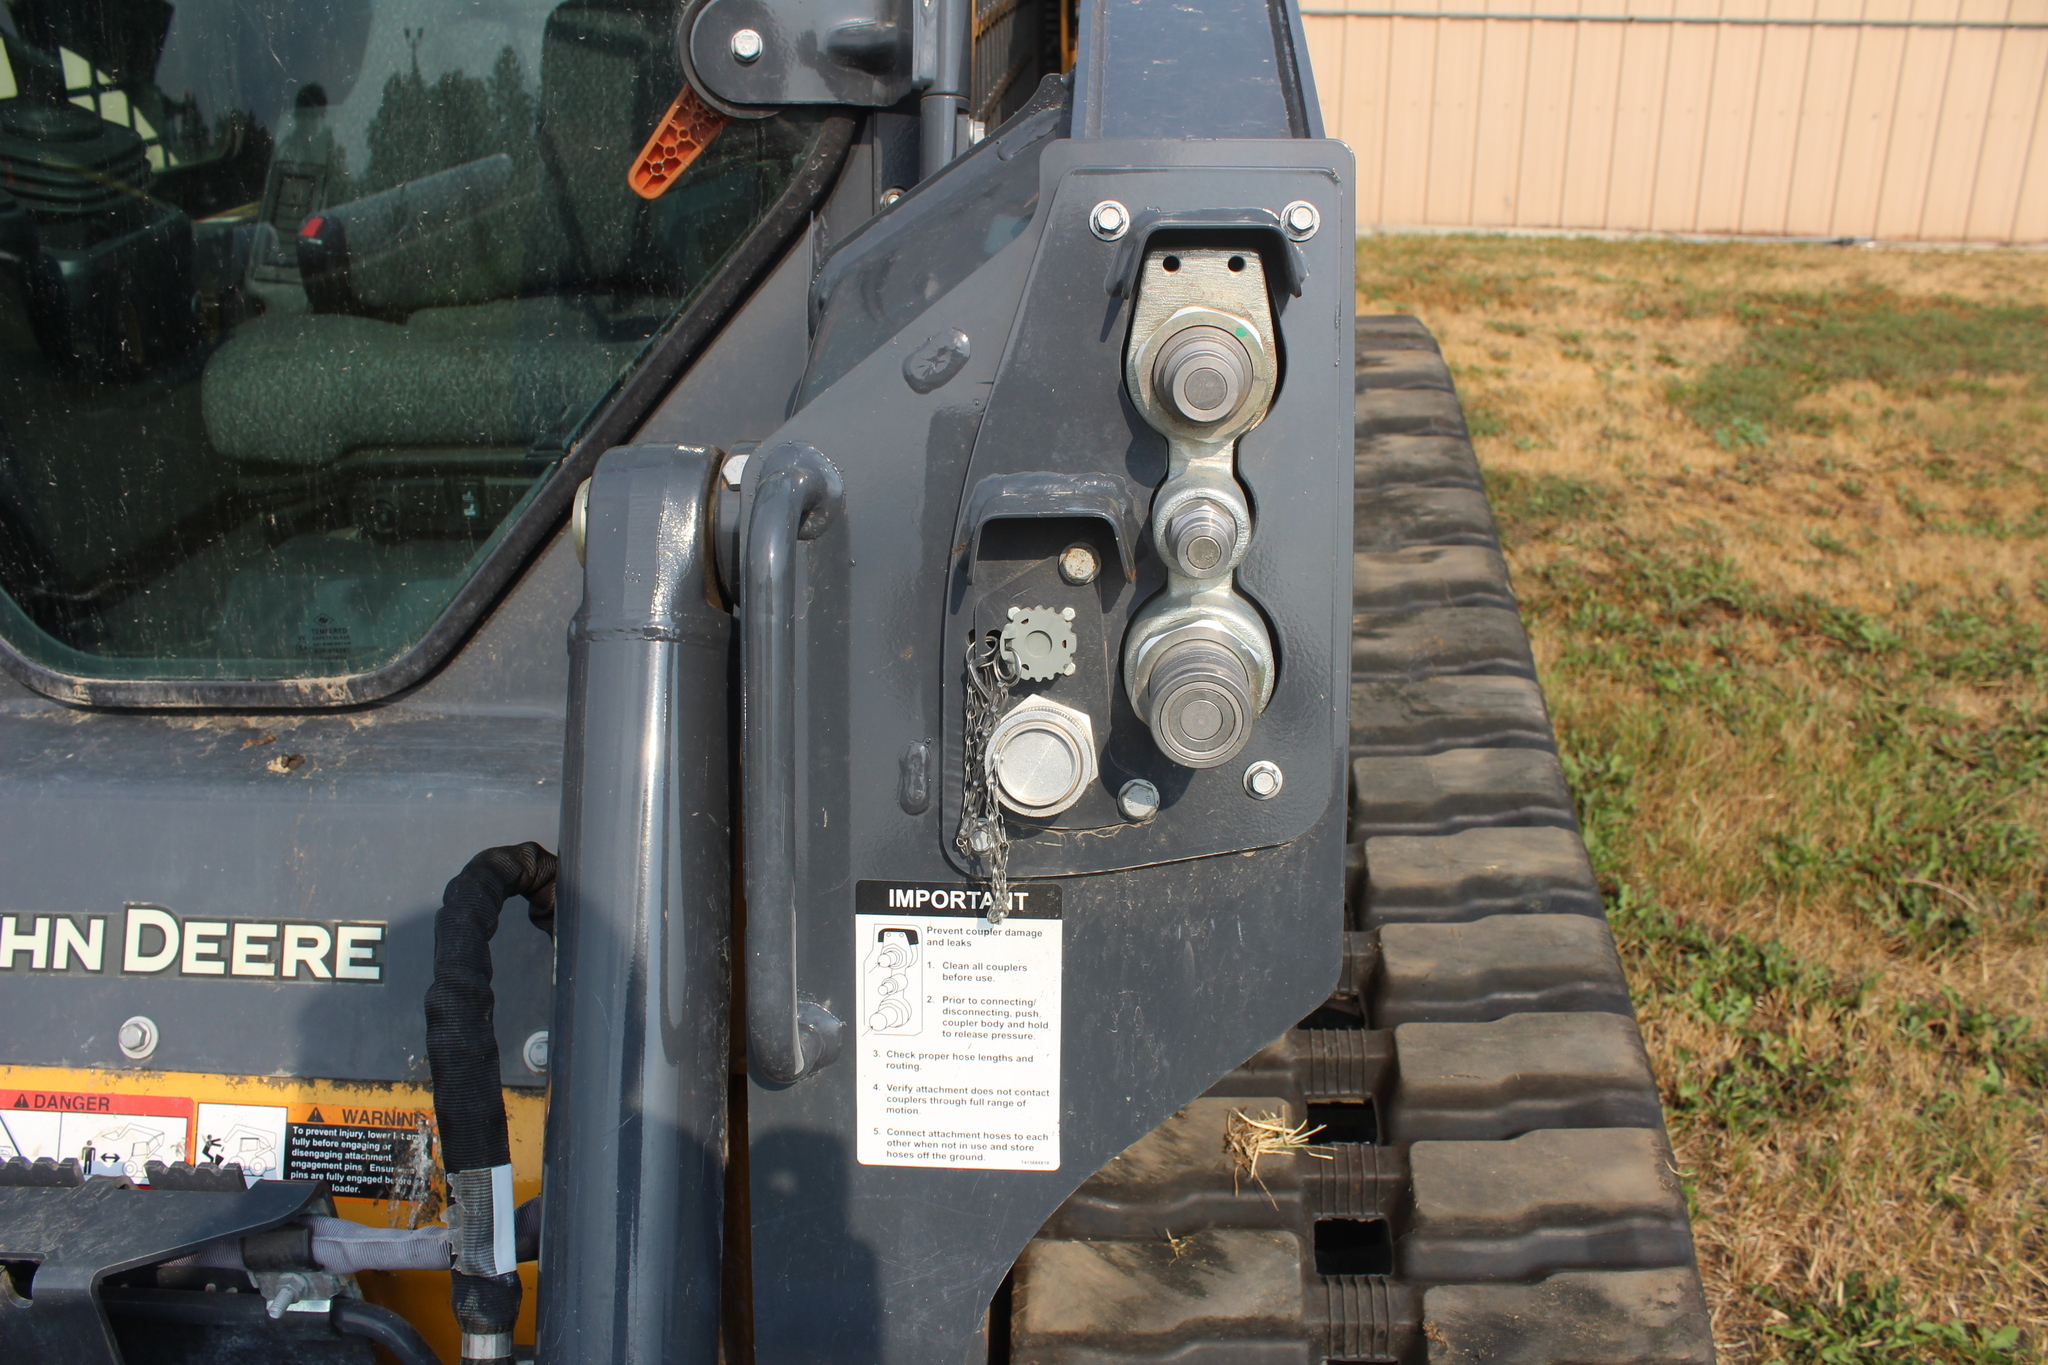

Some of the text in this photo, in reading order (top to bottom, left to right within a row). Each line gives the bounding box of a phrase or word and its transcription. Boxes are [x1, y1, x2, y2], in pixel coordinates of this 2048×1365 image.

[927, 927, 1043, 938] Prevent coupler damage
[123, 908, 383, 980] DEERE
[927, 939, 972, 947] and leaks
[943, 962, 969, 970] Clean
[972, 963, 983, 971] all
[986, 963, 1028, 973] couplers
[942, 974, 973, 982] before
[943, 996, 965, 1004] Prior
[981, 998, 1036, 1007] connecting/
[942, 1008, 1012, 1018] disconnecting,
[942, 1019, 978, 1028] coupler
[981, 1020, 1004, 1029] body
[955, 1031, 989, 1039] release
[991, 1033, 1036, 1041] pressure.
[873, 1050, 881, 1058] 3.
[887, 1051, 915, 1059] Check
[918, 1053, 950, 1061] proper
[953, 1053, 975, 1061] hose
[978, 1054, 1013, 1063] lengths
[886, 1062, 922, 1071] routing.
[887, 1084, 913, 1094] Verify
[916, 1086, 968, 1095] attachment
[971, 1087, 993, 1095] does
[34, 1095, 110, 1111] DANGER
[887, 1095, 927, 1105] couplers
[930, 1097, 966, 1106] through
[969, 1098, 984, 1106] full
[987, 1100, 1014, 1108] range
[887, 1106, 921, 1115] motion.
[293, 1126, 304, 1134] To
[306, 1128, 337, 1137] prevent
[339, 1129, 366, 1139] injury,
[368, 1131, 391, 1139] lower
[887, 1128, 926, 1137] Connect
[928, 1130, 980, 1139] attachment
[983, 1131, 1012, 1139] hoses
[1026, 1133, 1049, 1141] each
[292, 1138, 310, 1147] fully
[312, 1139, 339, 1147] before
[341, 1141, 380, 1151] engaging
[887, 1140, 911, 1148] other
[292, 1149, 392, 1161] disengaging attachment
[887, 1151, 914, 1159] hoses
[932, 1152, 947, 1160] the
[950, 1153, 985, 1162] ground.
[291, 1162, 342, 1171] engagement
[370, 1164, 394, 1172] Ensur
[291, 1171, 308, 1180] pins
[326, 1173, 344, 1182] fully
[347, 1174, 382, 1184] engaged
[332, 1184, 360, 1193] loader.
